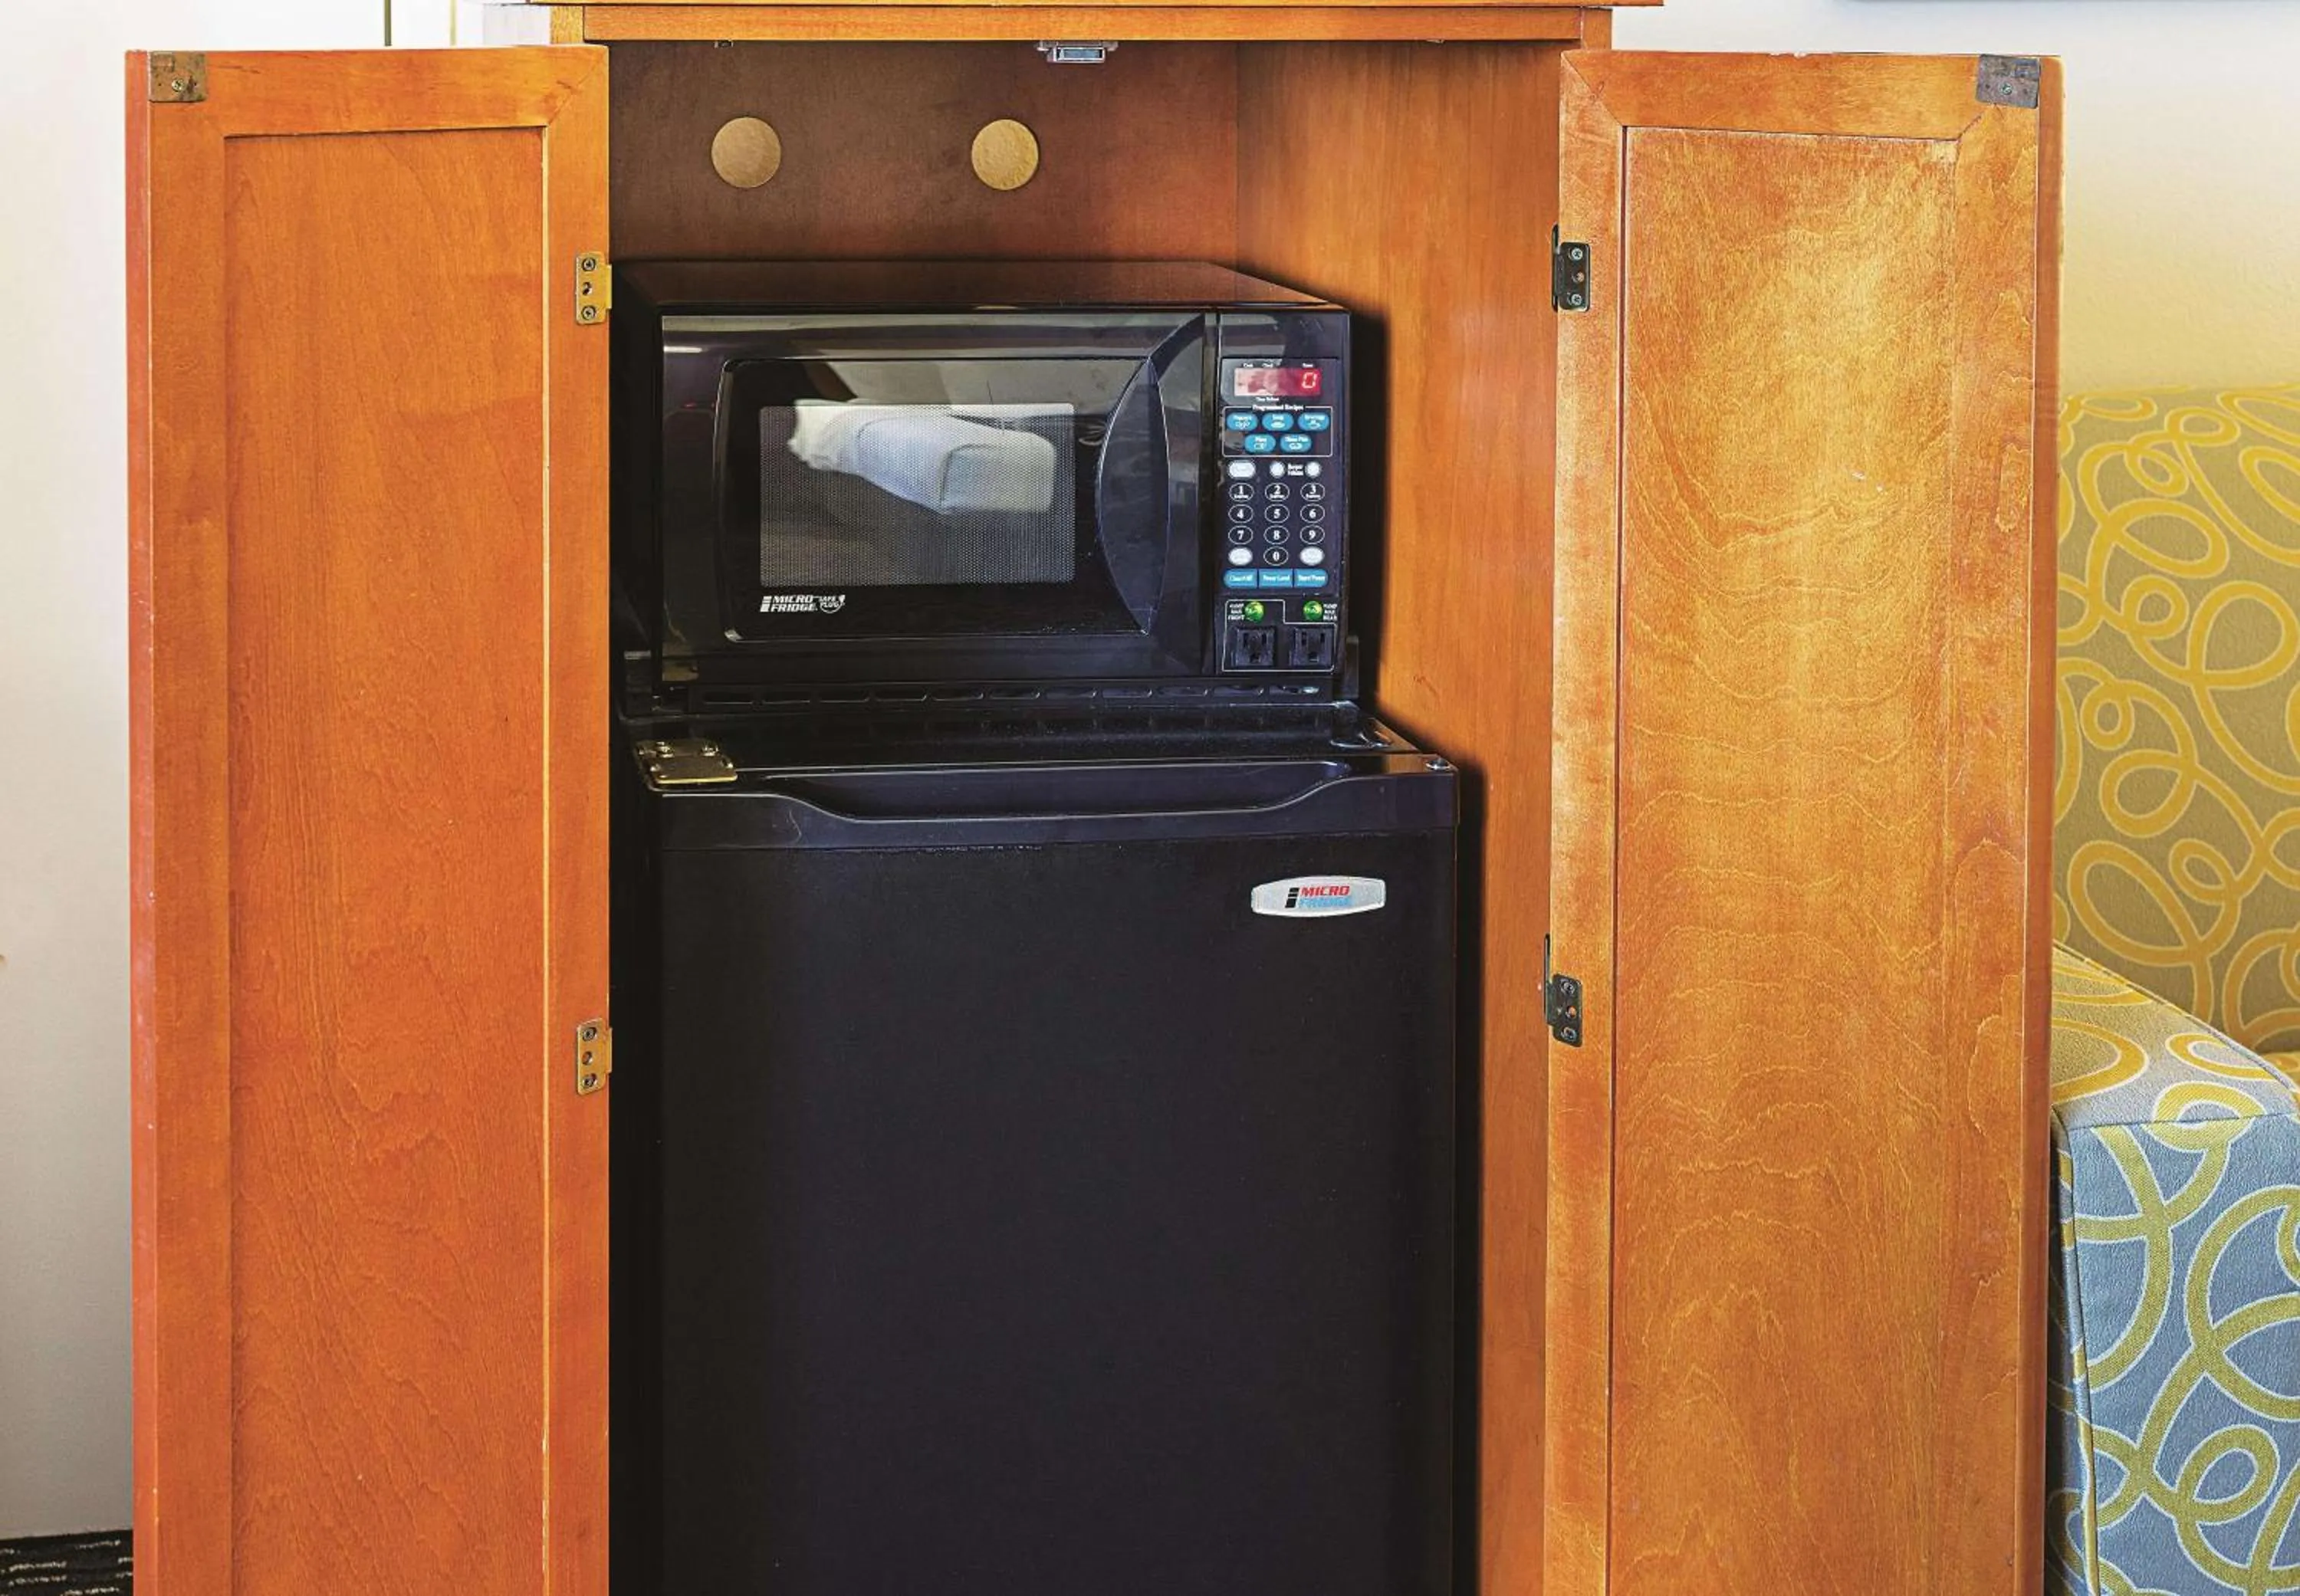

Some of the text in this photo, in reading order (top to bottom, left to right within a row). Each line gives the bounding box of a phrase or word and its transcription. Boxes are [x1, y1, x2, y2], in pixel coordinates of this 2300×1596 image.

[1238, 486, 1244, 494] 1
[1274, 485, 1280, 494] 2
[1311, 485, 1316, 494] 3
[1237, 510, 1244, 519] 4
[1273, 509, 1280, 519] 5
[1309, 509, 1316, 518] 6
[1237, 530, 1244, 540] 7
[1273, 530, 1280, 540] 8
[1309, 530, 1316, 540] 9
[1273, 552, 1279, 561] 0
[773, 595, 813, 603] MICRO
[1300, 886, 1350, 897] MICRO
